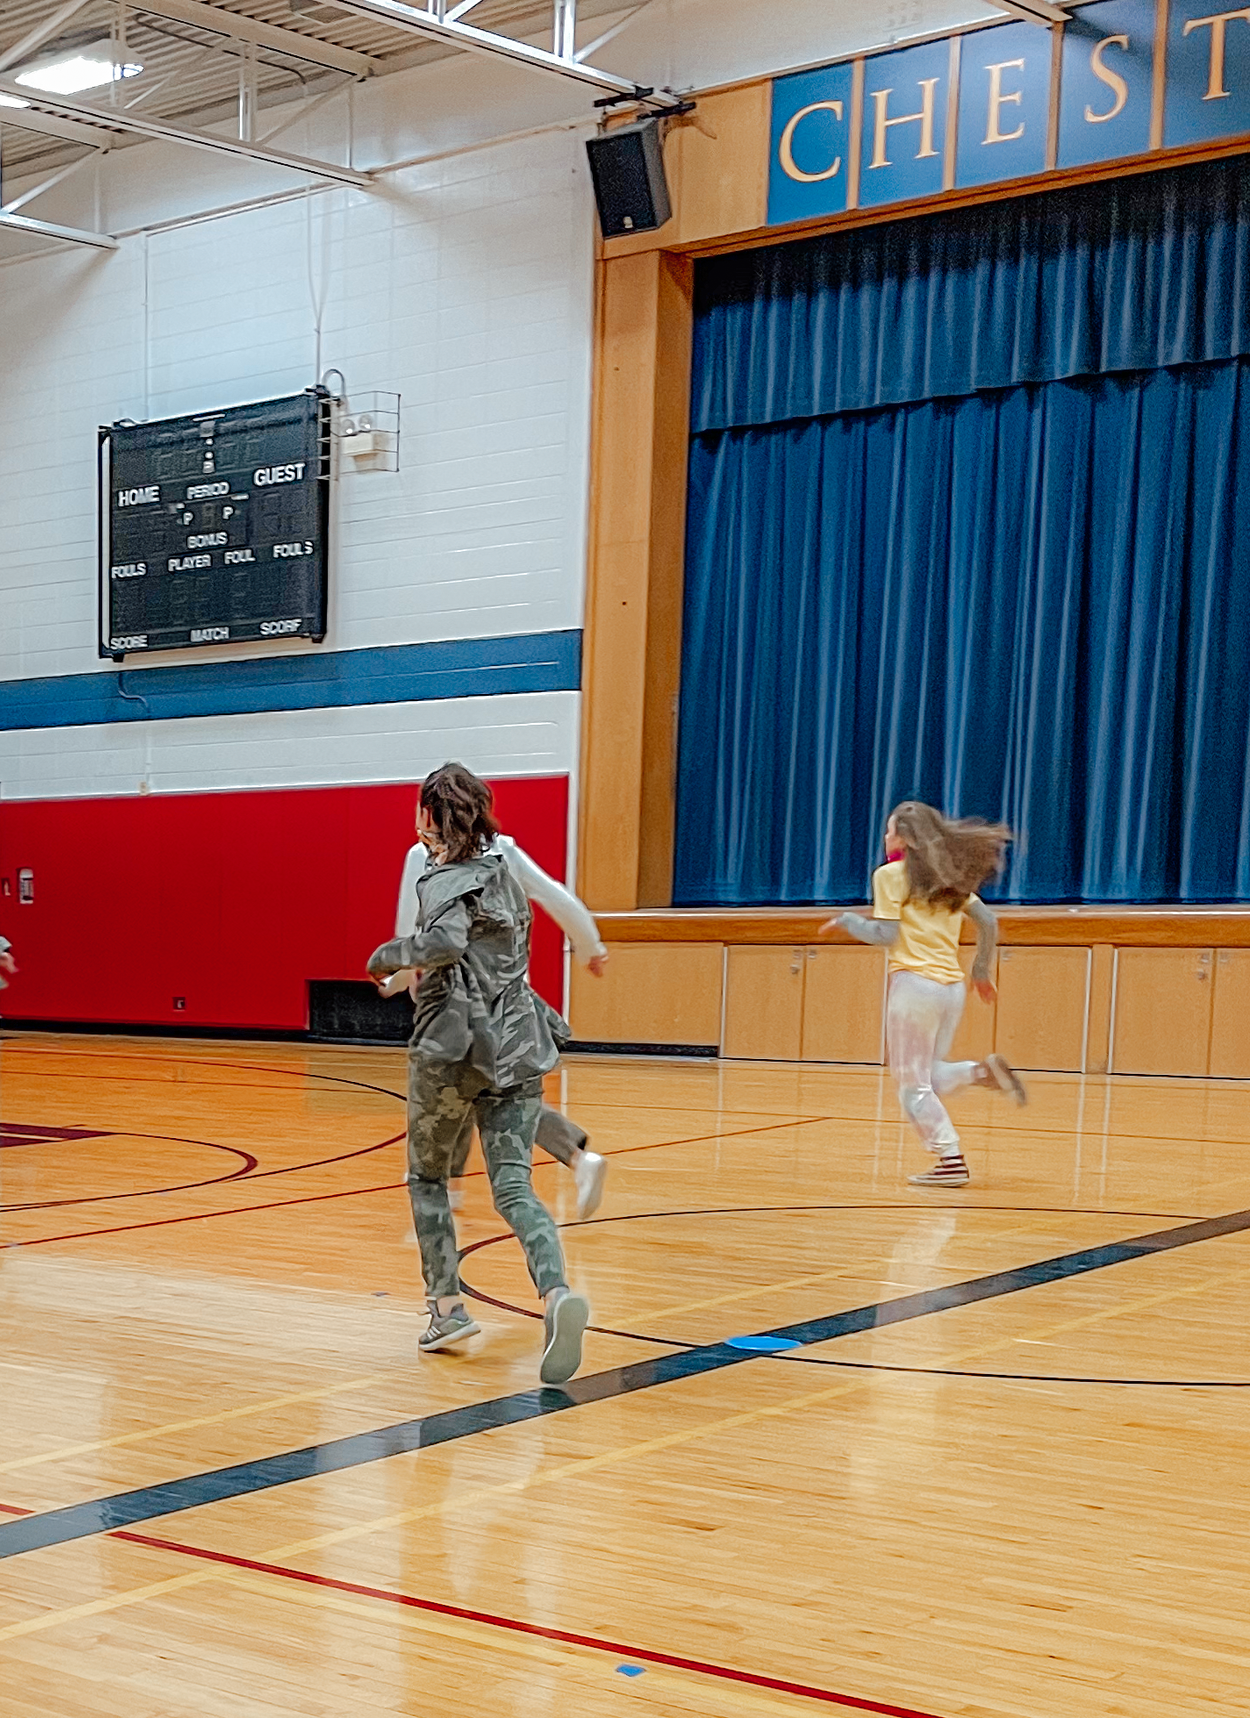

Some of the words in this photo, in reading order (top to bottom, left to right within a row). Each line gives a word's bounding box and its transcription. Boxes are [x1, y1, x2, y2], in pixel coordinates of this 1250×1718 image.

[778, 7, 1250, 183] CHEST
[253, 462, 306, 486] GUEST
[118, 485, 160, 507] HOME
[187, 481, 230, 500] PERIOD
[187, 531, 228, 549] BONUS
[273, 541, 313, 558] FOULS
[168, 554, 211, 572] PLAYER
[224, 549, 256, 565] FOUL
[111, 562, 146, 579] FOULS
[110, 634, 148, 650] SCORE
[190, 626, 229, 642] MATCH
